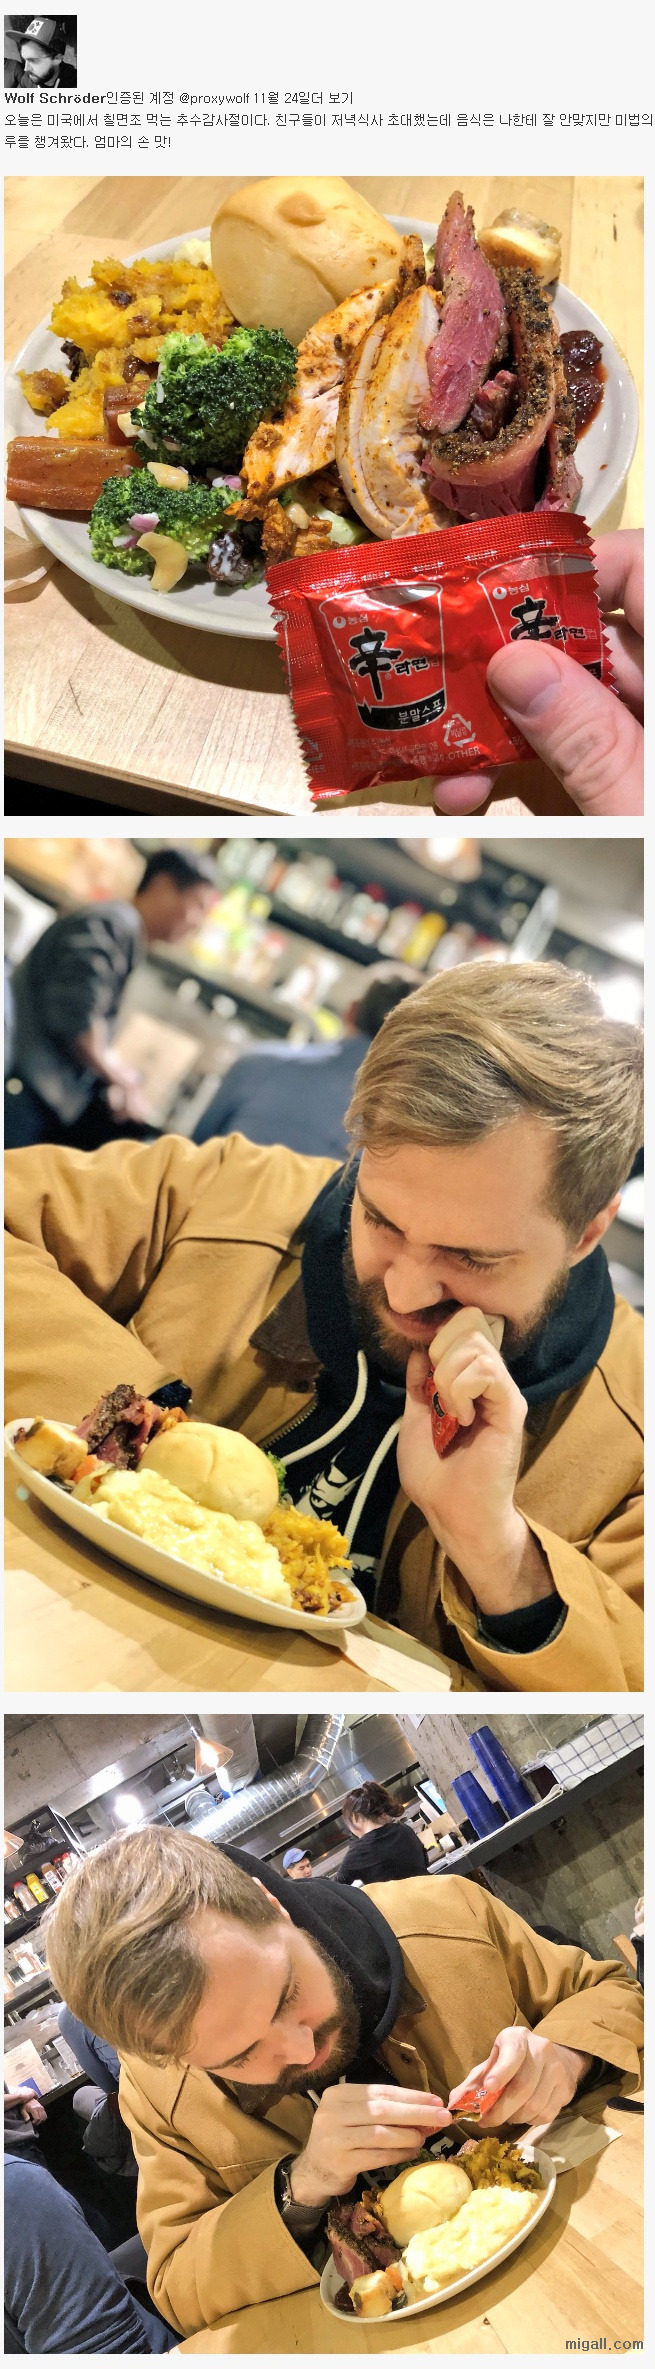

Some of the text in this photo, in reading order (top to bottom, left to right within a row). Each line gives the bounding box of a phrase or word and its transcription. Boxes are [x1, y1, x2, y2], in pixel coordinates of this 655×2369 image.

[508, 583, 530, 595] 농심
[347, 613, 368, 625] 농심
[348, 625, 403, 702] 辛
[398, 699, 442, 724] 분말스프
[448, 745, 481, 760] OTHER
